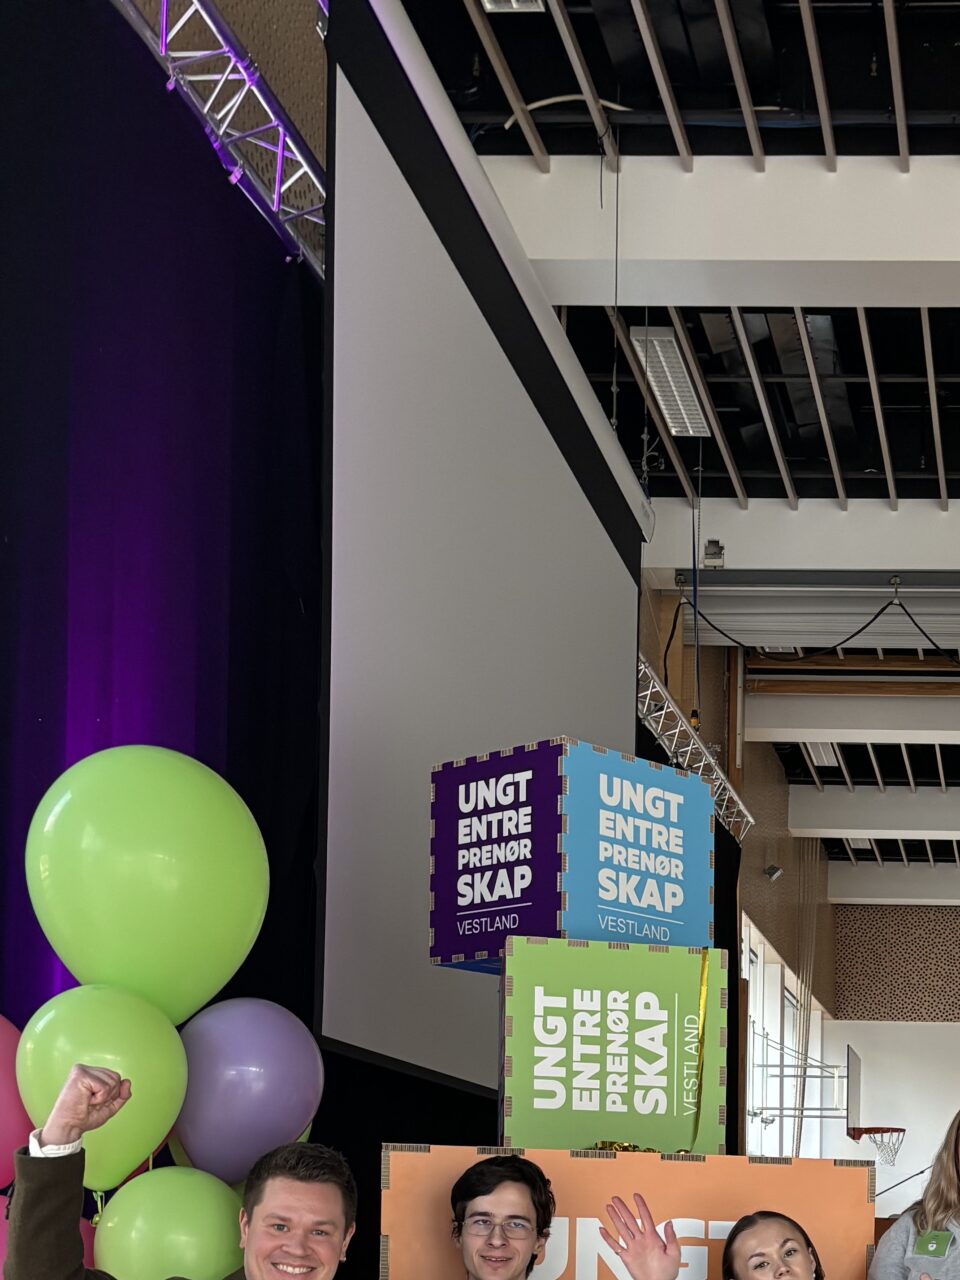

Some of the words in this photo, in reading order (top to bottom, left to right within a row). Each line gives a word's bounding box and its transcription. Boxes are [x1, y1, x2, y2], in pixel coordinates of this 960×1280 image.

[458, 770, 533, 813] UNGT
[599, 773, 684, 822] UNGT
[458, 806, 532, 844] ENTRE
[599, 812, 684, 854] ENTRE
[457, 839, 532, 870] PRENØR
[598, 841, 684, 880] PRENØR
[457, 865, 533, 906] SKAP
[598, 869, 684, 914] SKAP
[457, 914, 519, 935] VESTLAND
[598, 915, 669, 942] VESTLAND
[533, 986, 568, 1110] UNGT
[572, 989, 601, 1111] ENTRE
[606, 990, 629, 1112] PRENØR
[634, 991, 669, 1115] SKAP
[684, 1015, 699, 1116] VESTLAND
